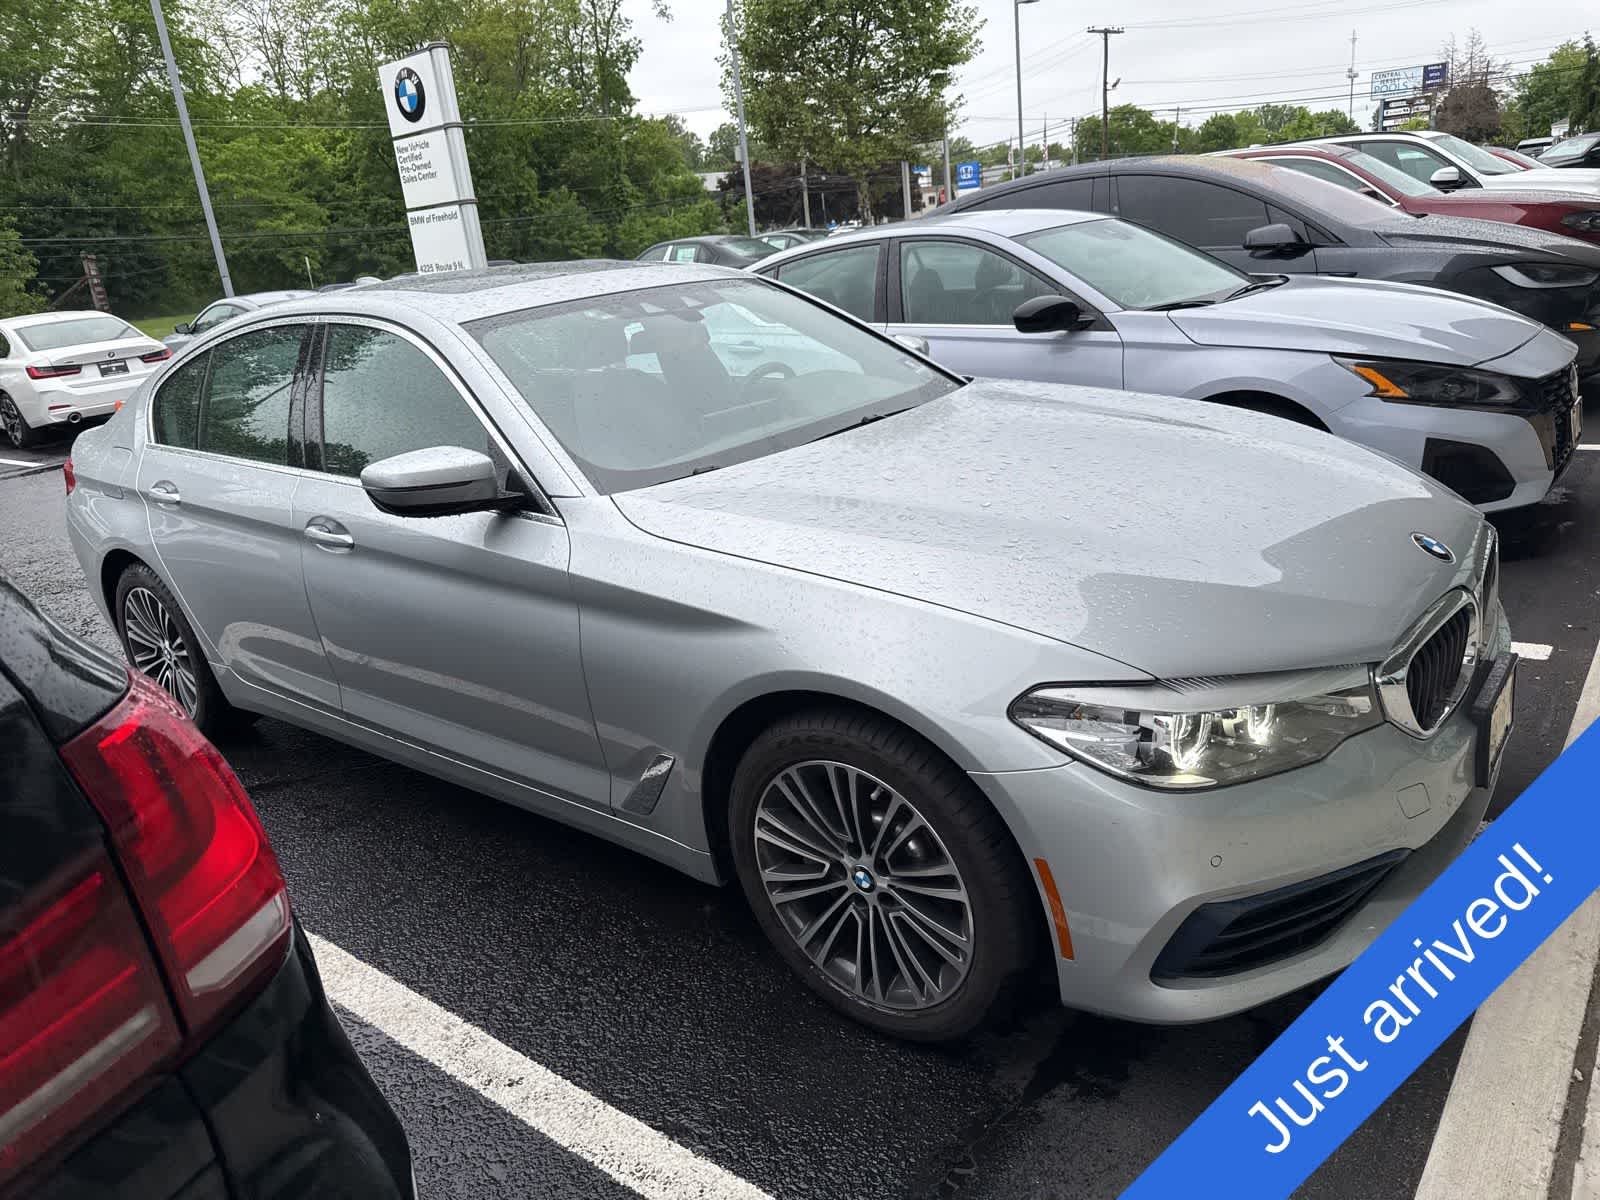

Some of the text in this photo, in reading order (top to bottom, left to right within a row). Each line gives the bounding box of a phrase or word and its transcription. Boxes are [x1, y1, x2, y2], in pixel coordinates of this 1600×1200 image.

[1374, 71, 1401, 80] CENTRAL
[1374, 81, 1409, 94] POOLS
[396, 140, 430, 154] New Vehicle
[398, 152, 422, 164] Certified
[400, 160, 432, 174] Pre-Owned
[402, 170, 438, 184] Sales Center
[409, 210, 459, 226] BMW of Freehold
[420, 263, 434, 273] 4225
[435, 262, 453, 272] Route
